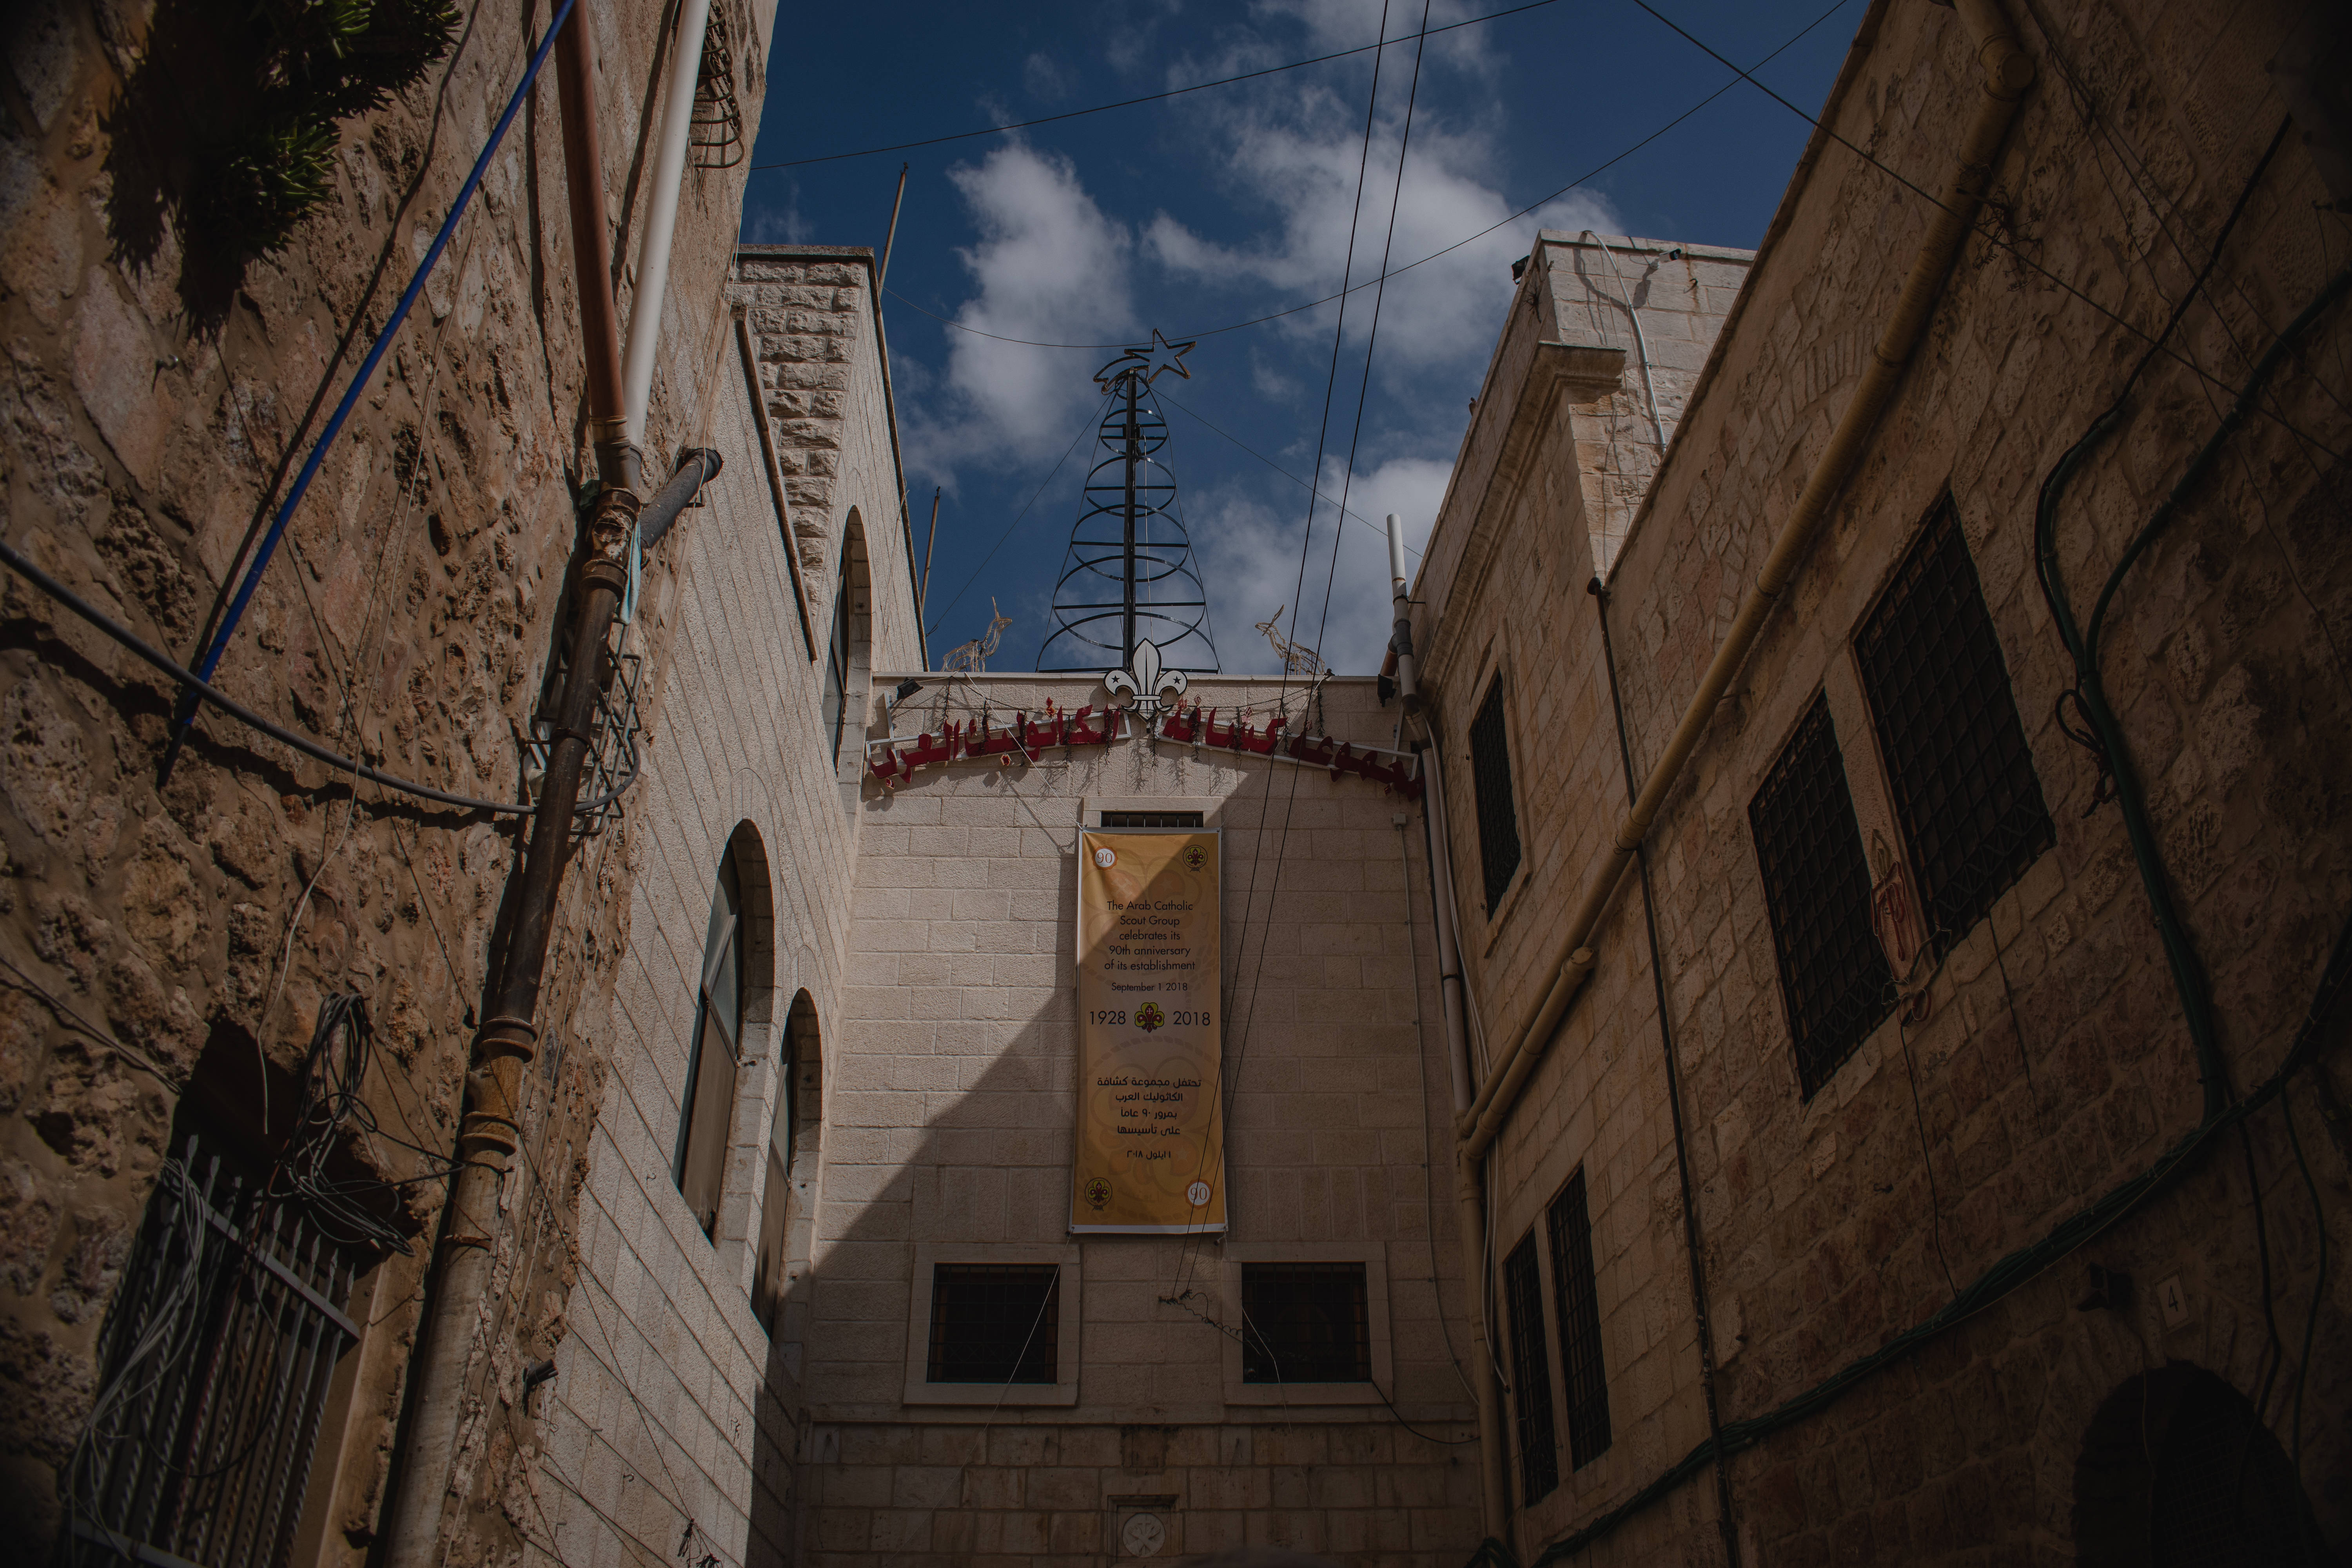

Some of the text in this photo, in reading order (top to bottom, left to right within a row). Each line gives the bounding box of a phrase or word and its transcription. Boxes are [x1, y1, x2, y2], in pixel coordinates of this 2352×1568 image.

[1162, 694, 1288, 755] كشافة
[869, 719, 960, 790] العرب
[1097, 852, 1113, 863] 90
[1107, 900, 1193, 910] The Arab Catholic
[1120, 915, 1180, 927] Scout Group
[1119, 930, 1180, 940] celebrates its
[1109, 946, 1191, 957] 90th anniversary
[1104, 959, 1195, 971] of its establishment
[1111, 983, 1188, 993] September 1 2018
[1089, 1011, 1126, 1025] 1928
[1173, 1012, 1211, 1026] 2018
[1097, 1076, 1201, 1088] تحتفل مجموعة كشافة
[1116, 1092, 1183, 1102] الكاثوليك العرب
[1142, 1109, 1150, 1117] ٩٠
[1154, 1111, 1177, 1119] بمرور
[1118, 1123, 1181, 1136] على تأسيسها
[1190, 1187, 1208, 1200] 90
[2169, 1285, 2178, 1311] 4
